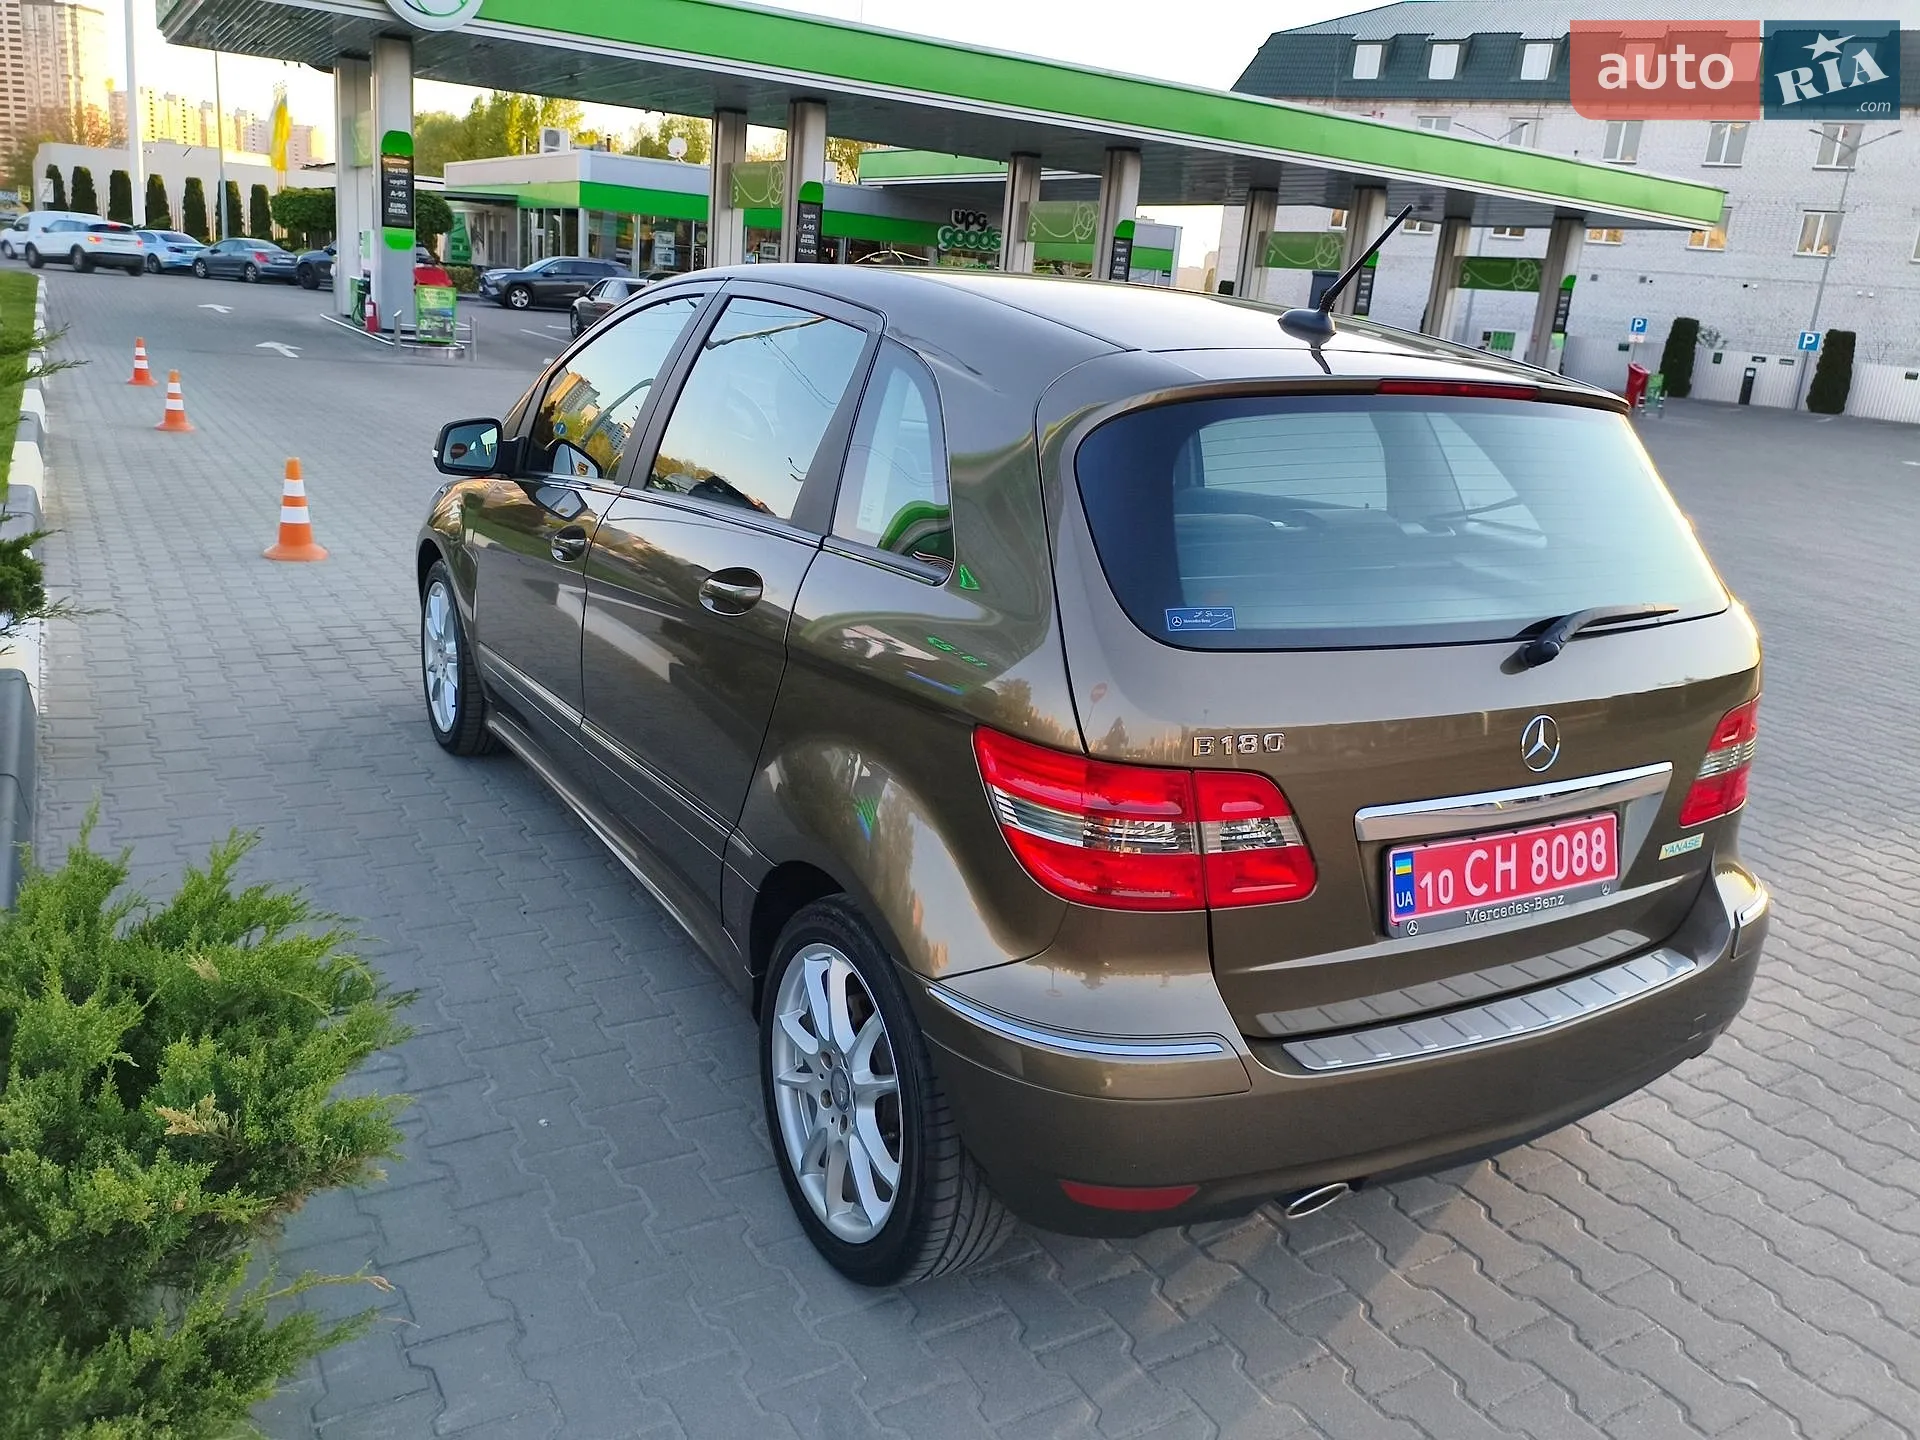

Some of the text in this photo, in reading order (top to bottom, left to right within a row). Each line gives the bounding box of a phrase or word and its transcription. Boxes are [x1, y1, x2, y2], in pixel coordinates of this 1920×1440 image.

[391, 190, 406, 198] A-95
[952, 209, 988, 232] upg
[938, 225, 1002, 252] goods
[1802, 333, 1815, 349] P
[1418, 826, 1608, 908] 10 CH 8088
[1396, 890, 1415, 909] UA
[1465, 893, 1566, 926] Mercedes-Benz
